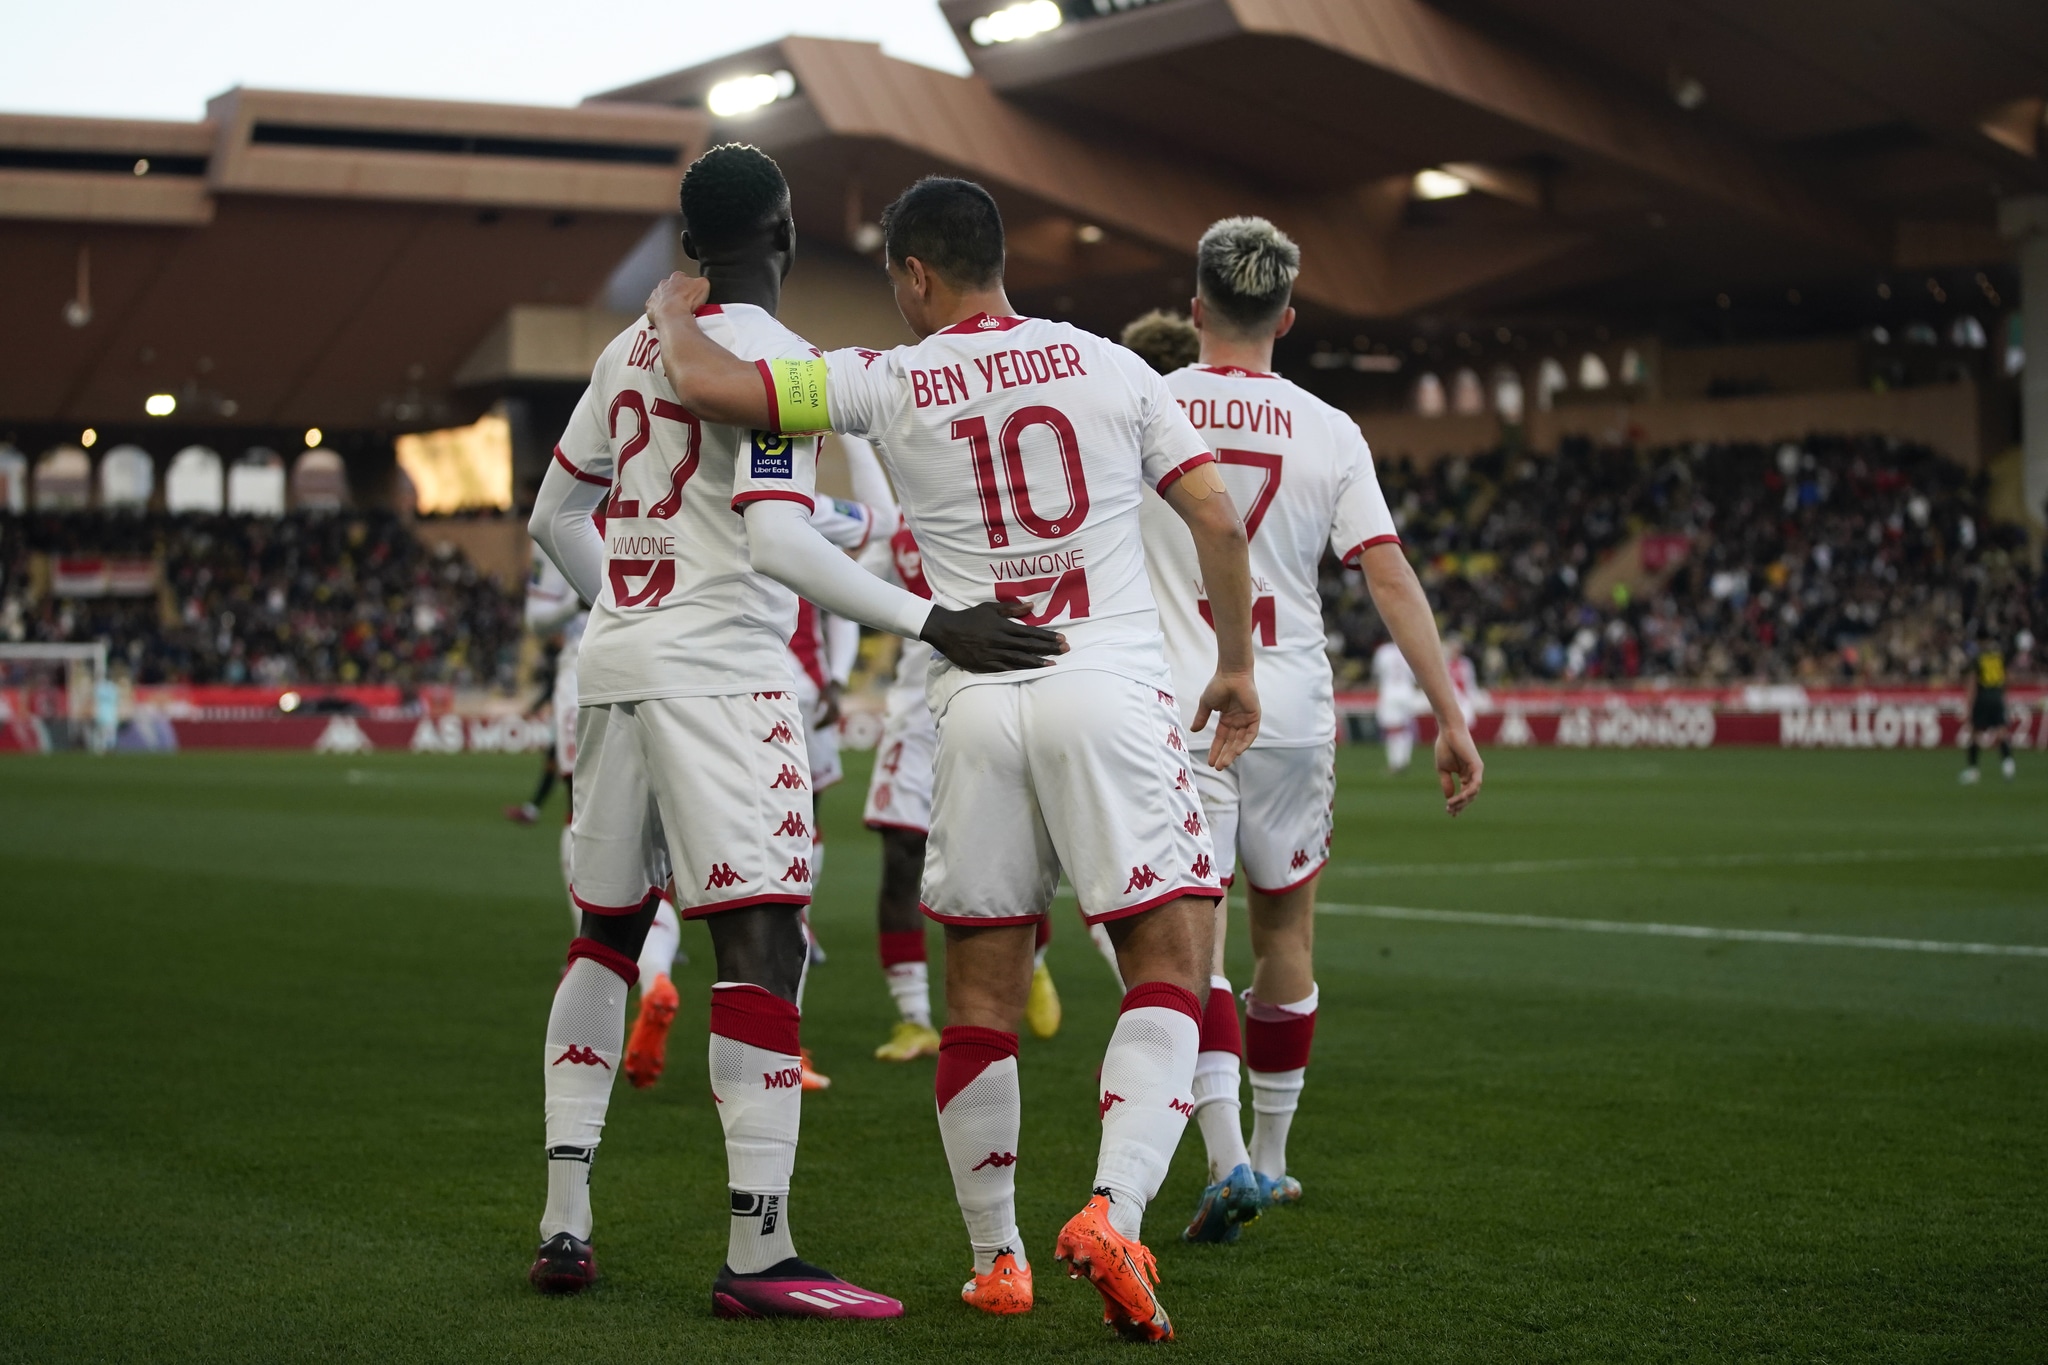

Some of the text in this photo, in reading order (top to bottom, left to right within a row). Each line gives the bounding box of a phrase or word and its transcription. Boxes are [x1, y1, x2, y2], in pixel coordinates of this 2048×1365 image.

[789, 366, 802, 404] RESPECT
[910, 343, 1087, 408] BEN YEDDER
[606, 389, 701, 520] 27
[951, 405, 1090, 550] 10
[613, 536, 675, 556] VIWONE
[989, 549, 1085, 582] VIWONE
[1193, 577, 1273, 596] VNE
[412, 714, 464, 753] AS
[470, 714, 557, 752] MON
[1557, 706, 1594, 748] AS
